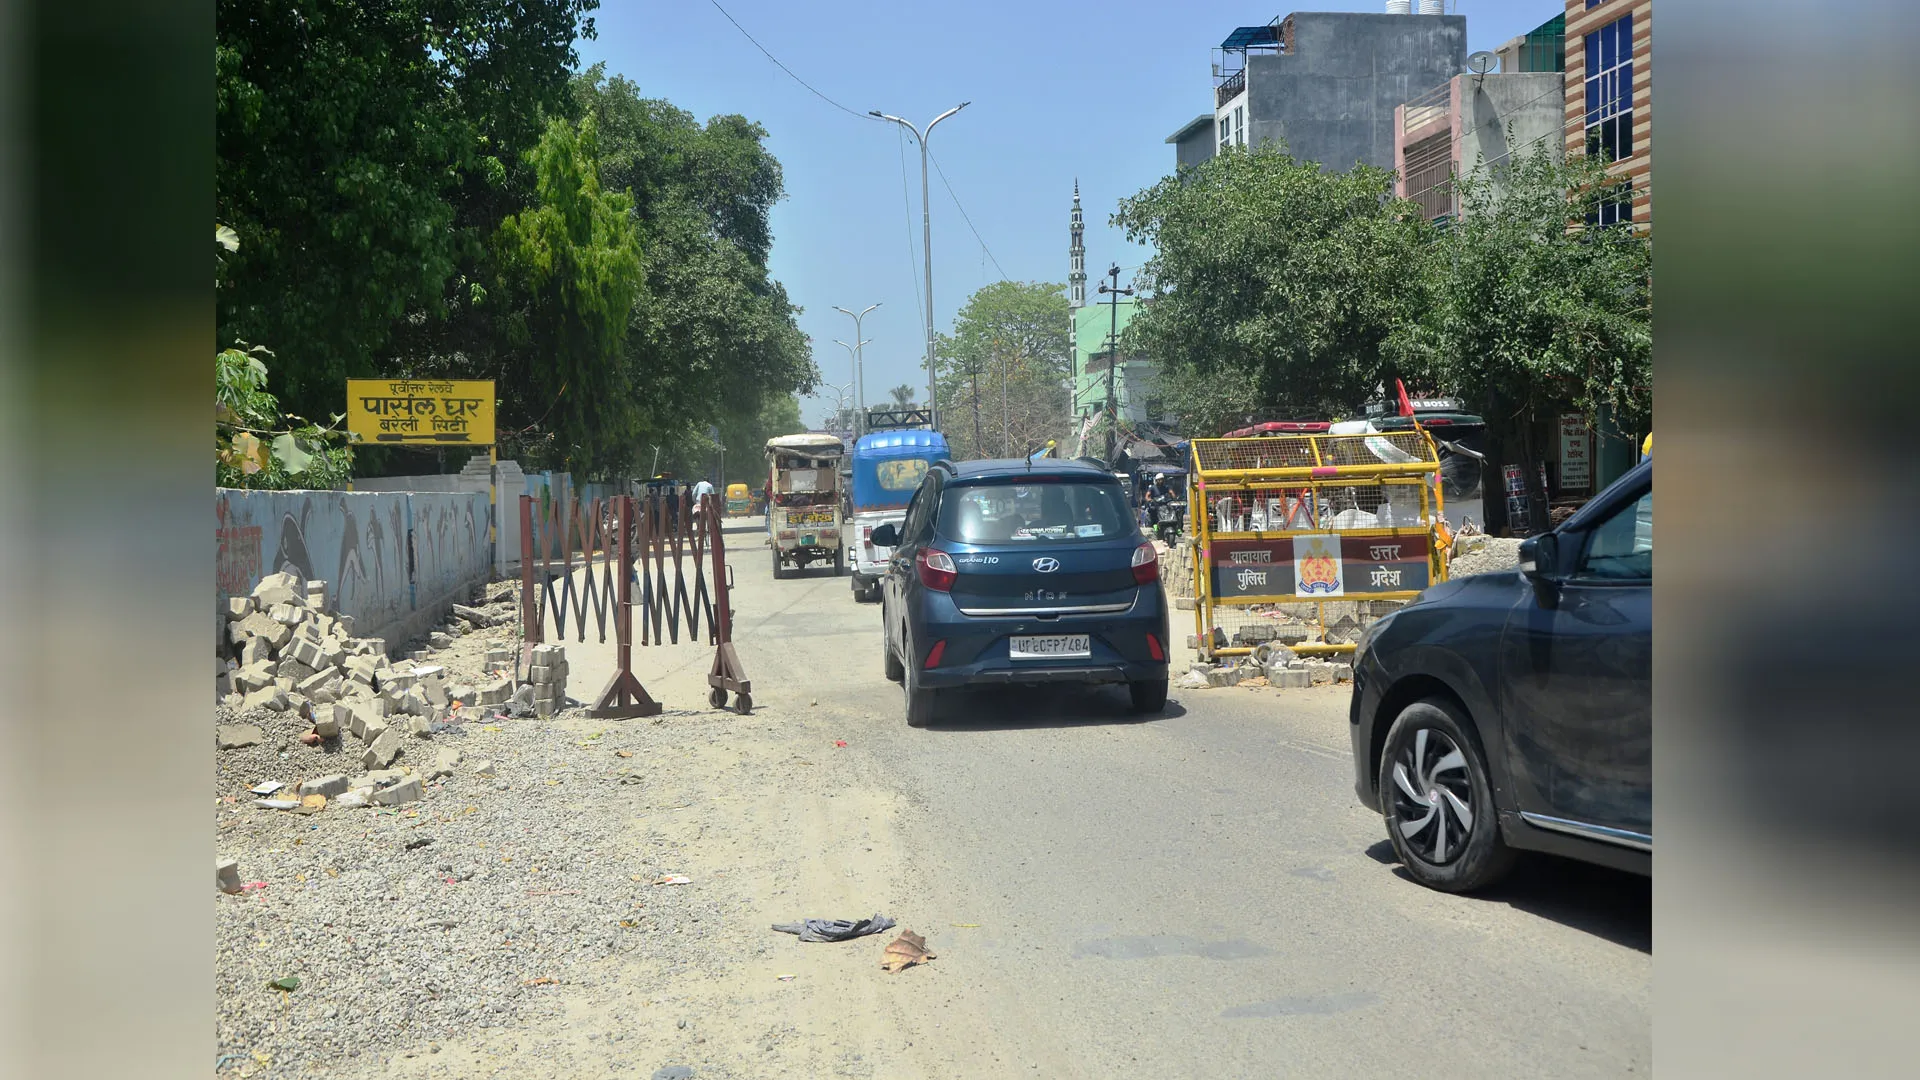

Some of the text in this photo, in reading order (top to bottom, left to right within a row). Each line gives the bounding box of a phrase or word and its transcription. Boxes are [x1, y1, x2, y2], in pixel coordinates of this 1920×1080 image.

[389, 381, 455, 395] पूर्वोत्तर रेलवे
[440, 398, 484, 417] घर
[379, 415, 468, 432] बरेली सिटी
[1230, 550, 1272, 564] यातायात
[1370, 545, 1401, 560] उत्तर
[1237, 569, 1267, 590] पुलिस
[1370, 565, 1401, 587] प्रदेश
